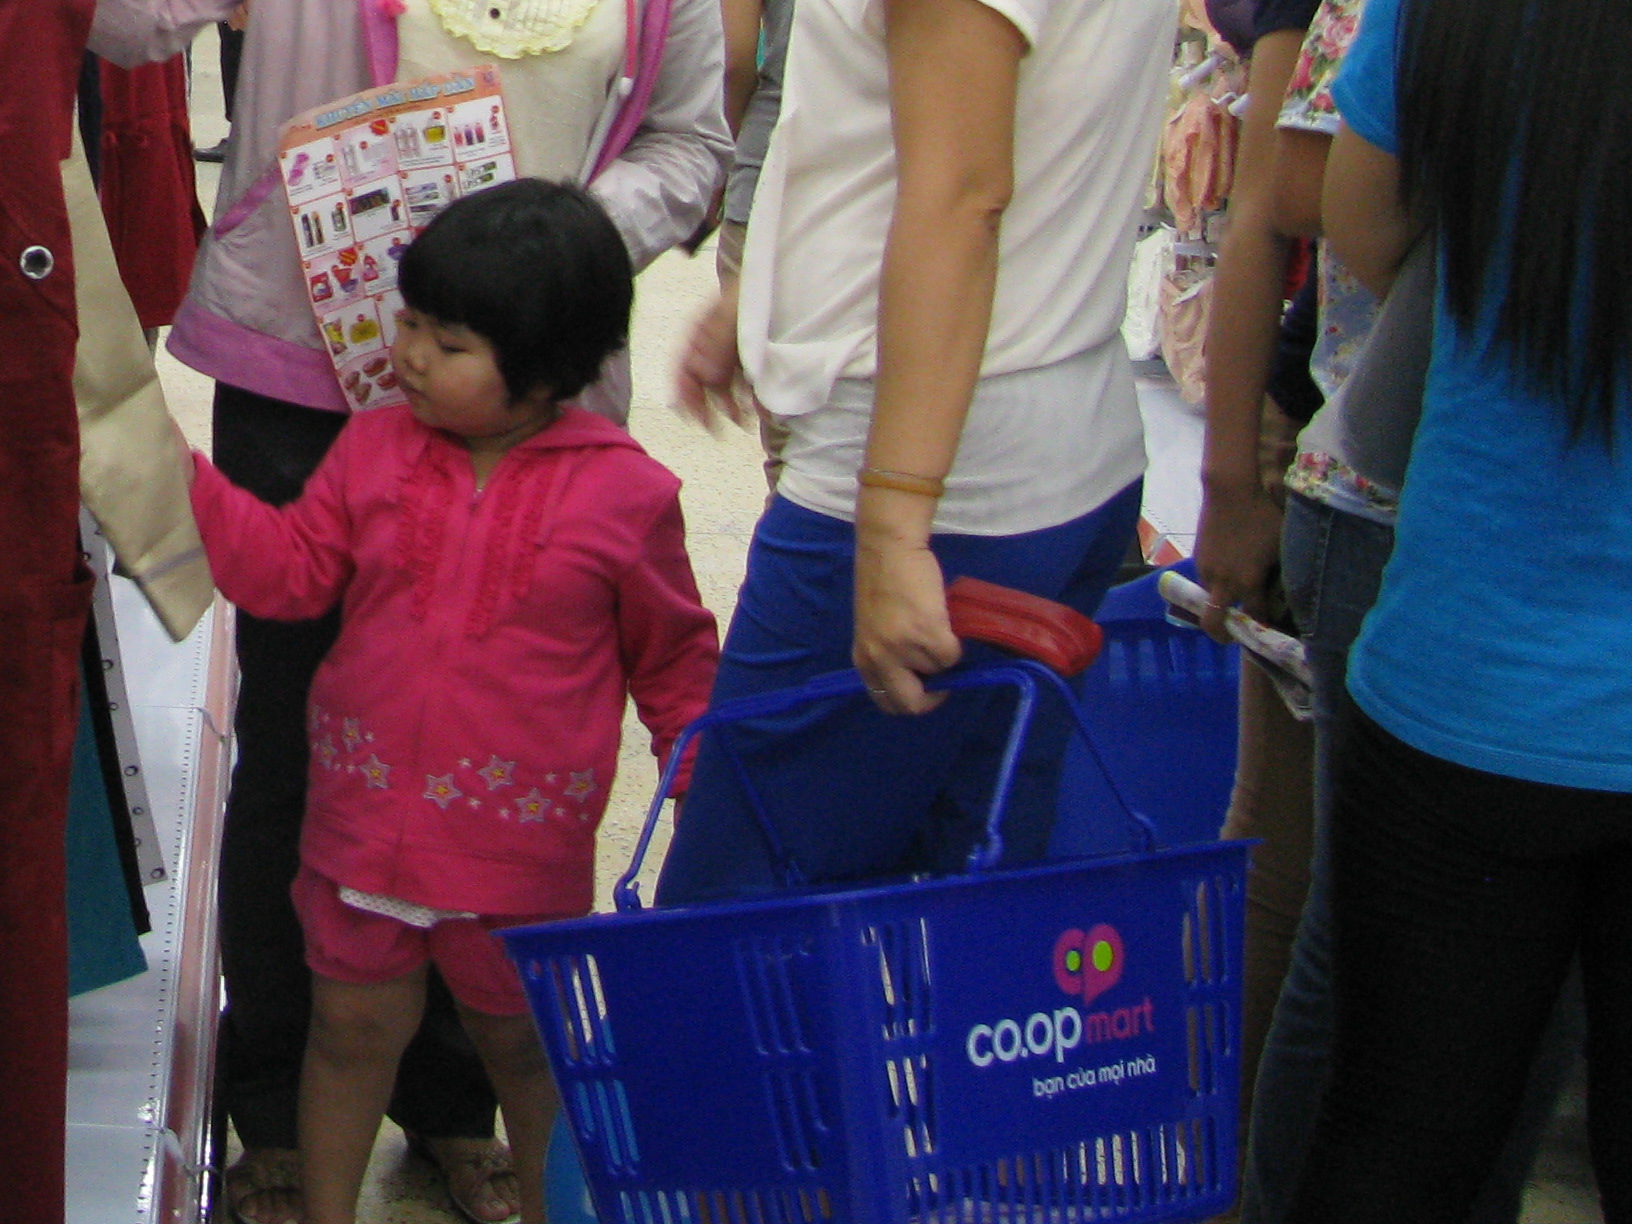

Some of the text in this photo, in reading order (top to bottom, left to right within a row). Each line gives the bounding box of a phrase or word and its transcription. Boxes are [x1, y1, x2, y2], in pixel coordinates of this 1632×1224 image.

[1032, 1053, 1157, 1099] bạn của mọi nhà
